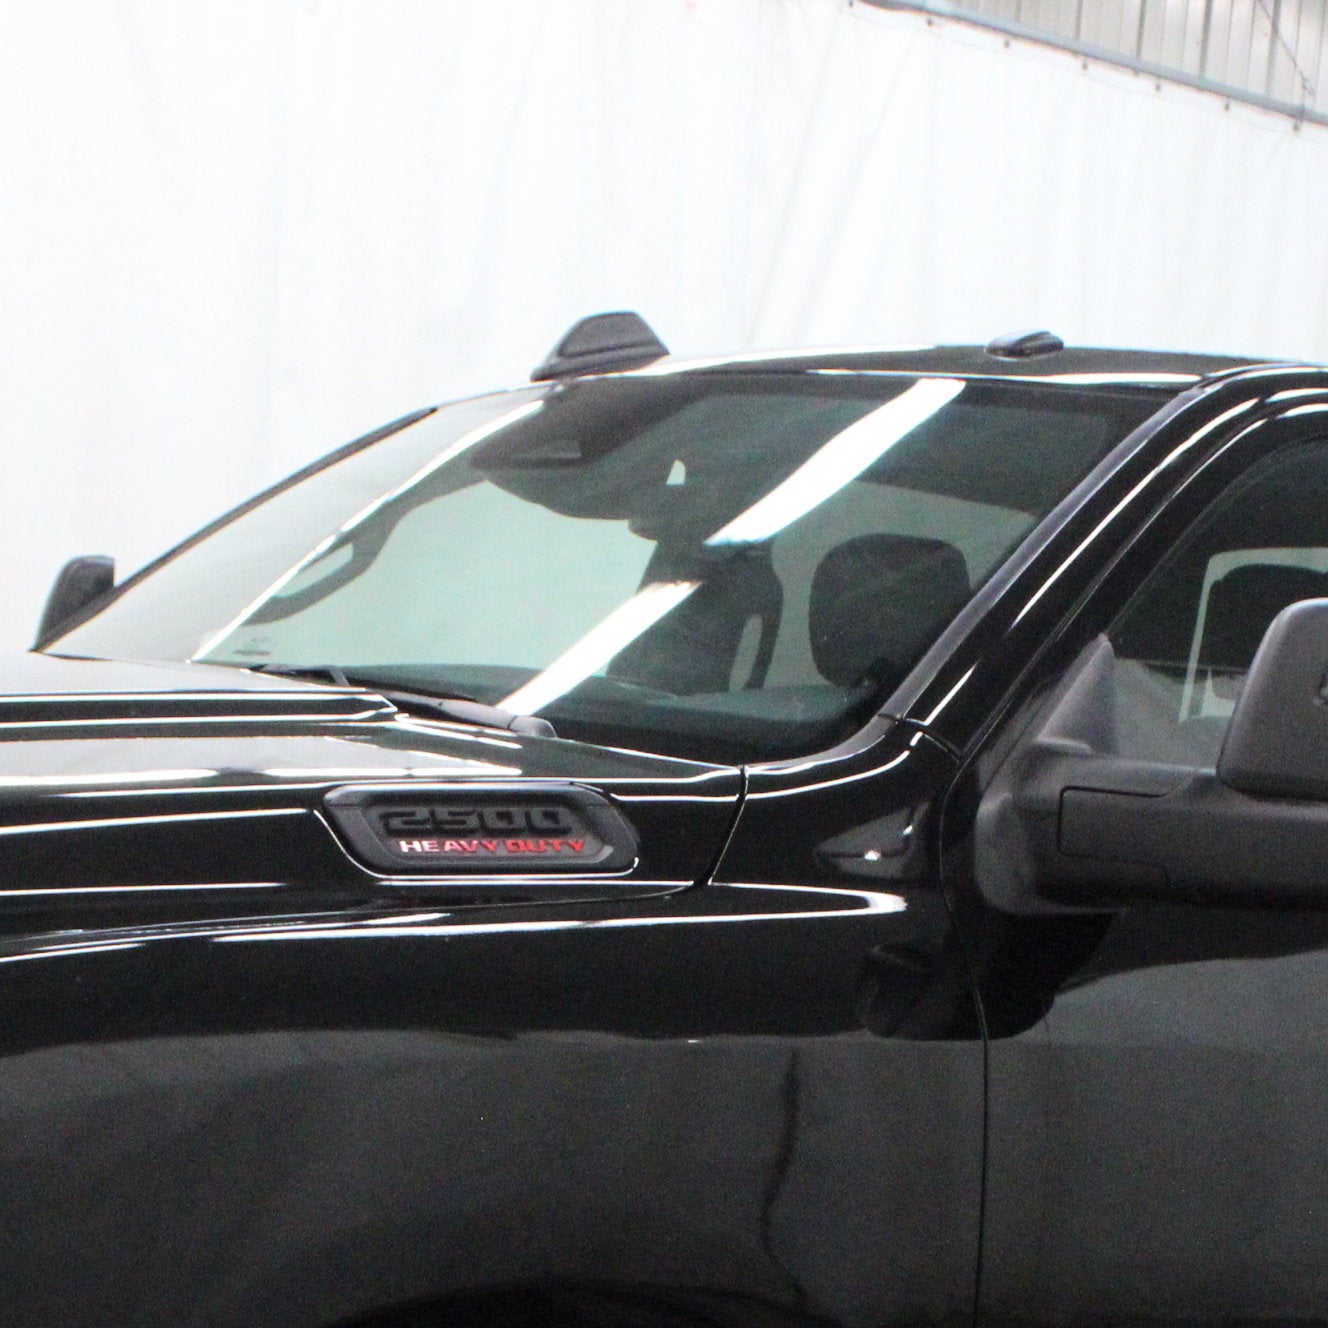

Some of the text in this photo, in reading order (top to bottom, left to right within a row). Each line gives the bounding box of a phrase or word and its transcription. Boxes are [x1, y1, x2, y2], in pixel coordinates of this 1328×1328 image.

[378, 806, 572, 836] 2500
[399, 839, 586, 855] HEAVY DUTY
